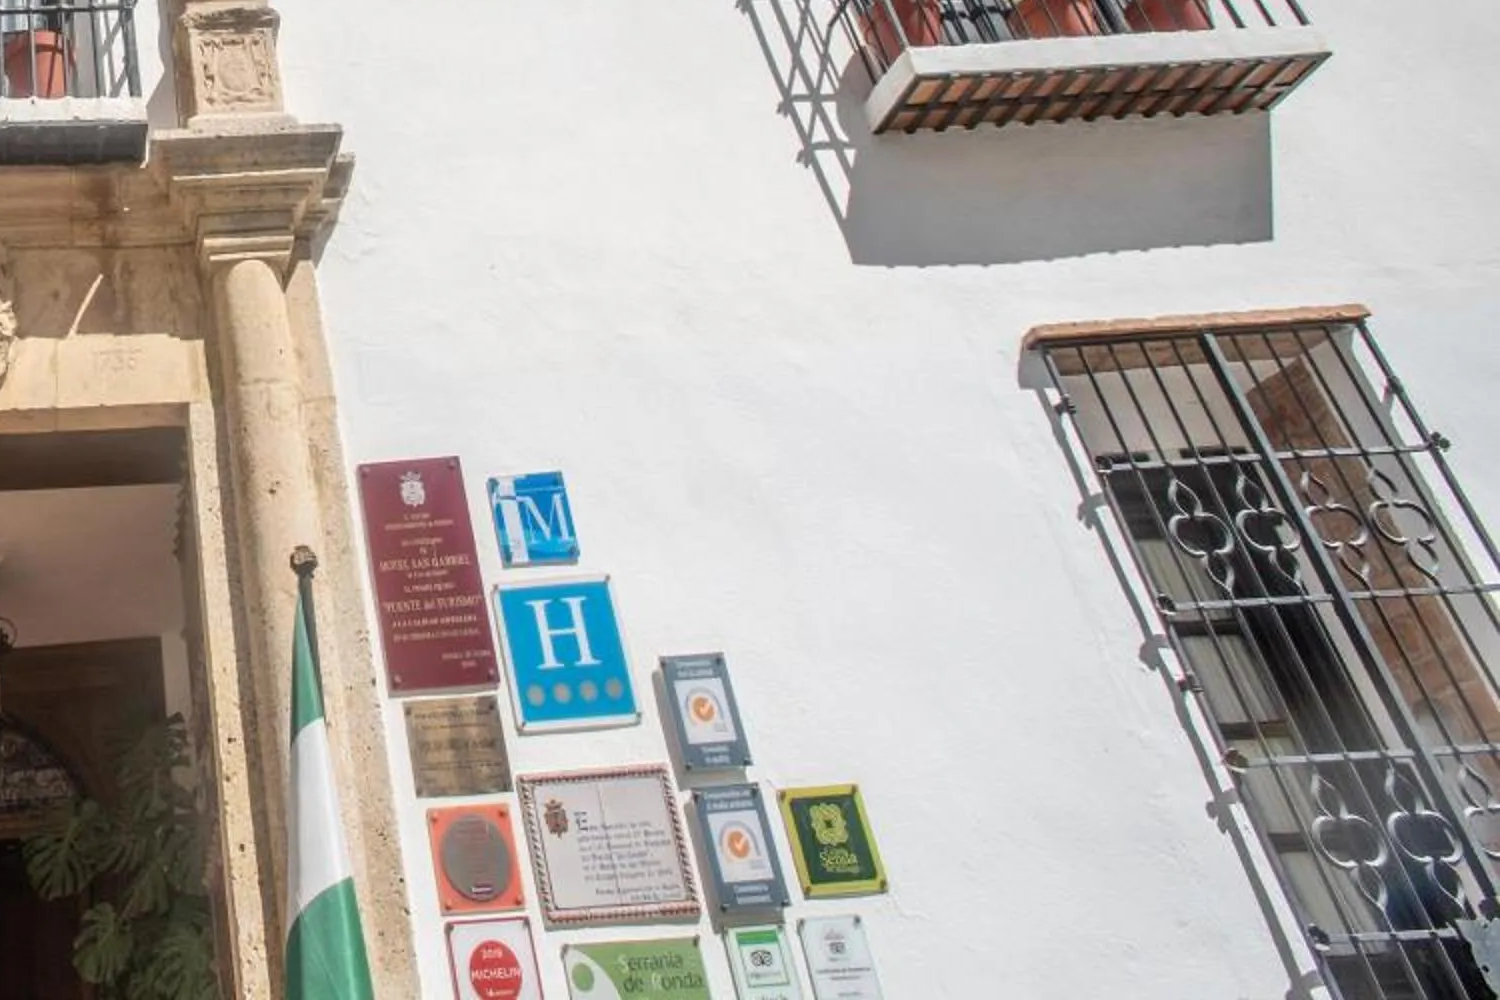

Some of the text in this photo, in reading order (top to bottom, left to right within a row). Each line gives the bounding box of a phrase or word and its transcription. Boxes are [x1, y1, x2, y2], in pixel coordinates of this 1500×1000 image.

[524, 596, 603, 670] H
[471, 966, 521, 981] MICHELIN
[651, 970, 703, 992] Ronda
